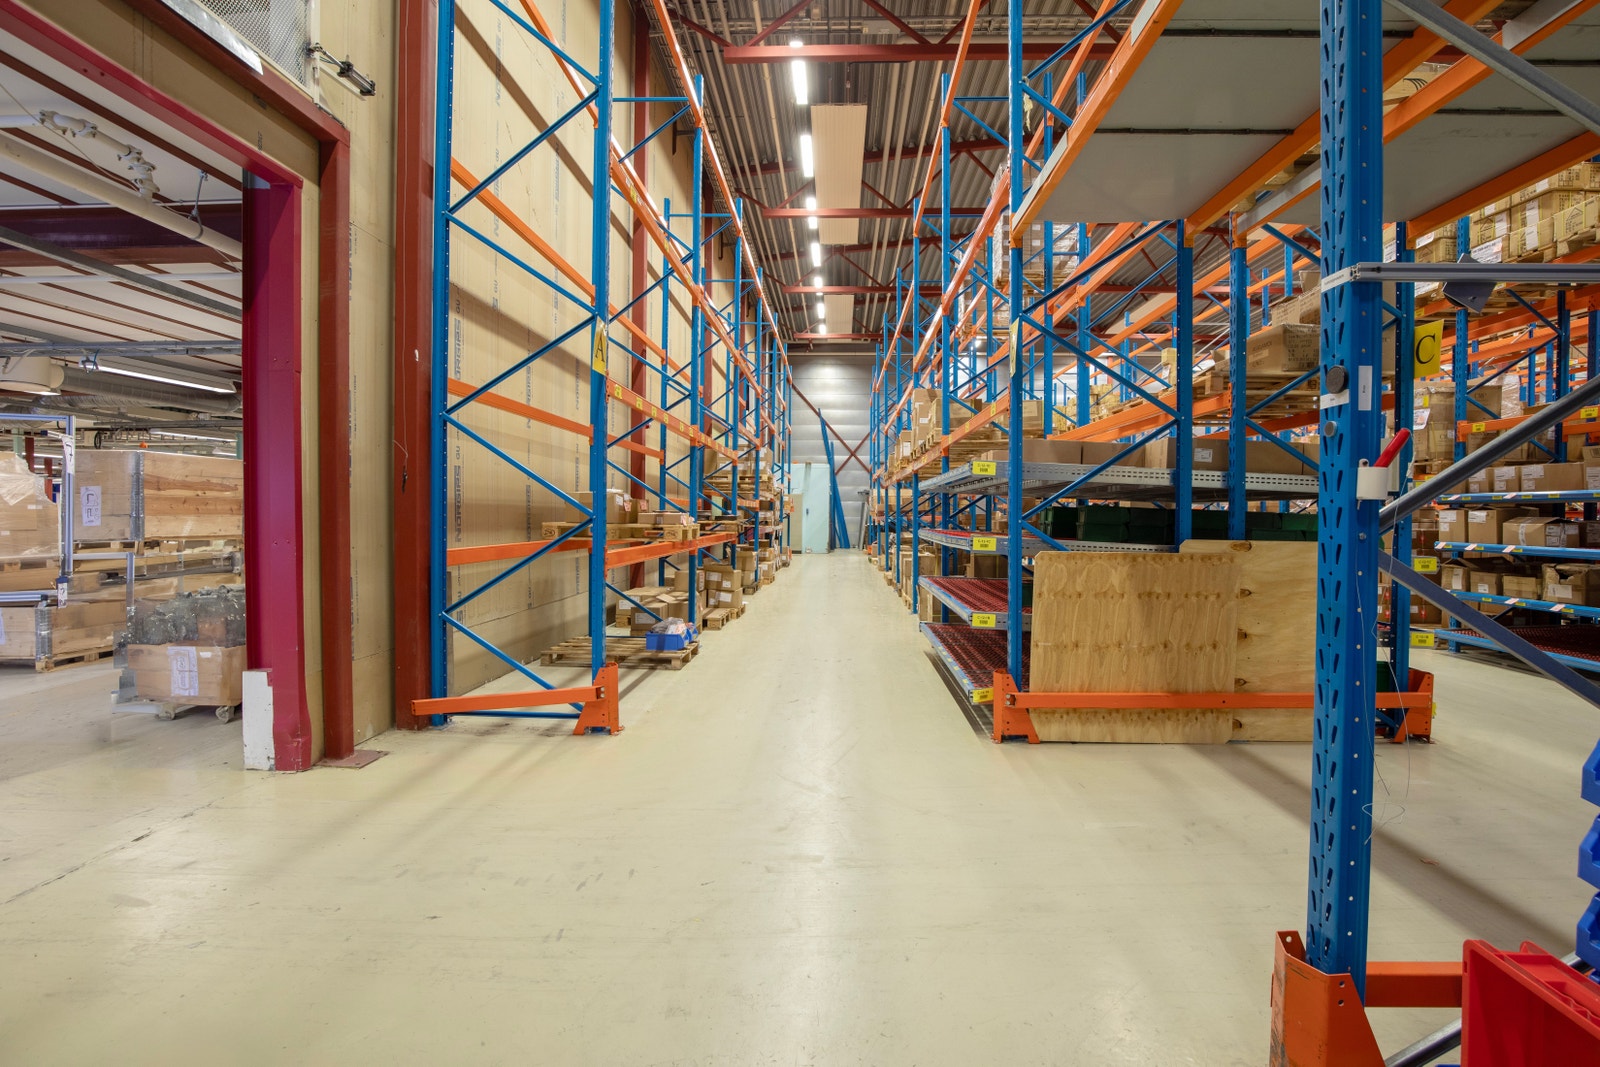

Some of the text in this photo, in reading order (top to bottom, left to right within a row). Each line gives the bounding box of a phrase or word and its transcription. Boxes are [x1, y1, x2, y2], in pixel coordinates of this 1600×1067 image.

[595, 332, 605, 362] A
[1415, 333, 1436, 365] C
[454, 465, 462, 543] NORGIPS
